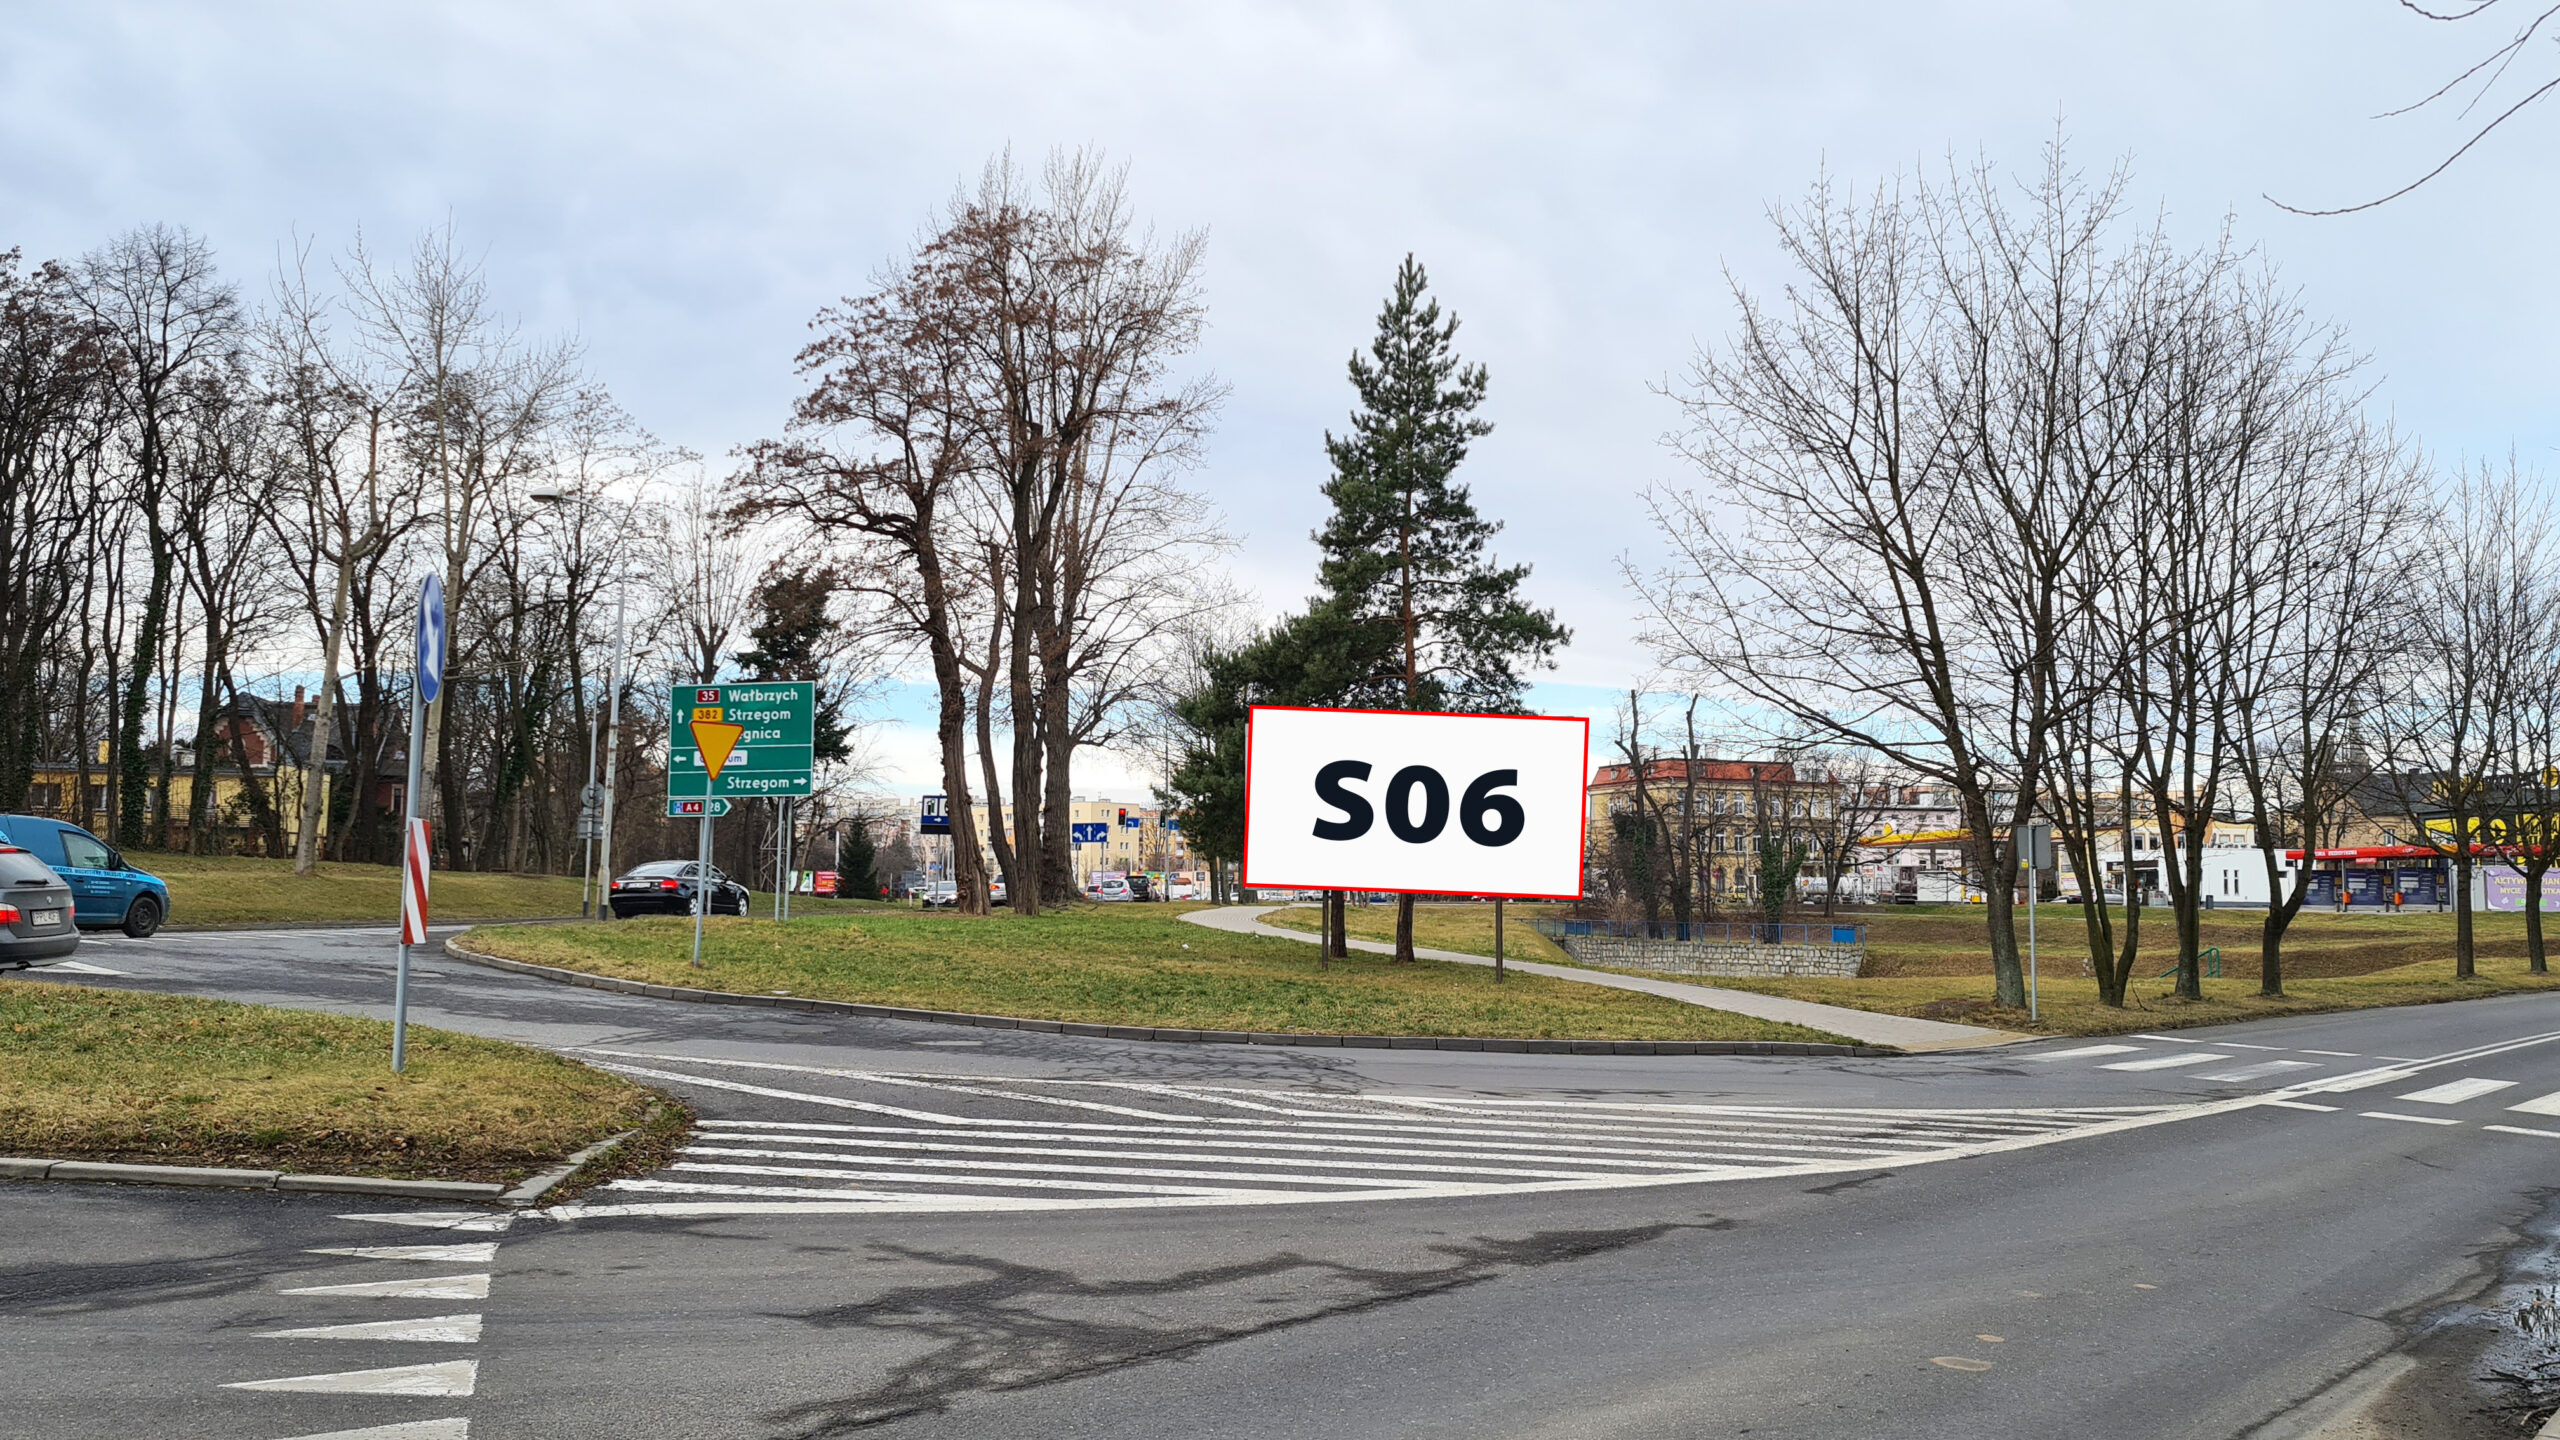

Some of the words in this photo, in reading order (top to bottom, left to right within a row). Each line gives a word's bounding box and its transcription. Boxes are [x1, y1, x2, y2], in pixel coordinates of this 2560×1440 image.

[702, 691, 715, 701] 35
[728, 688, 798, 704] Wałbrzych
[698, 710, 718, 720] 382
[729, 708, 791, 723] Strzegom
[739, 727, 781, 743] gnica
[727, 776, 789, 792] Strzegom
[685, 802, 700, 812] A4
